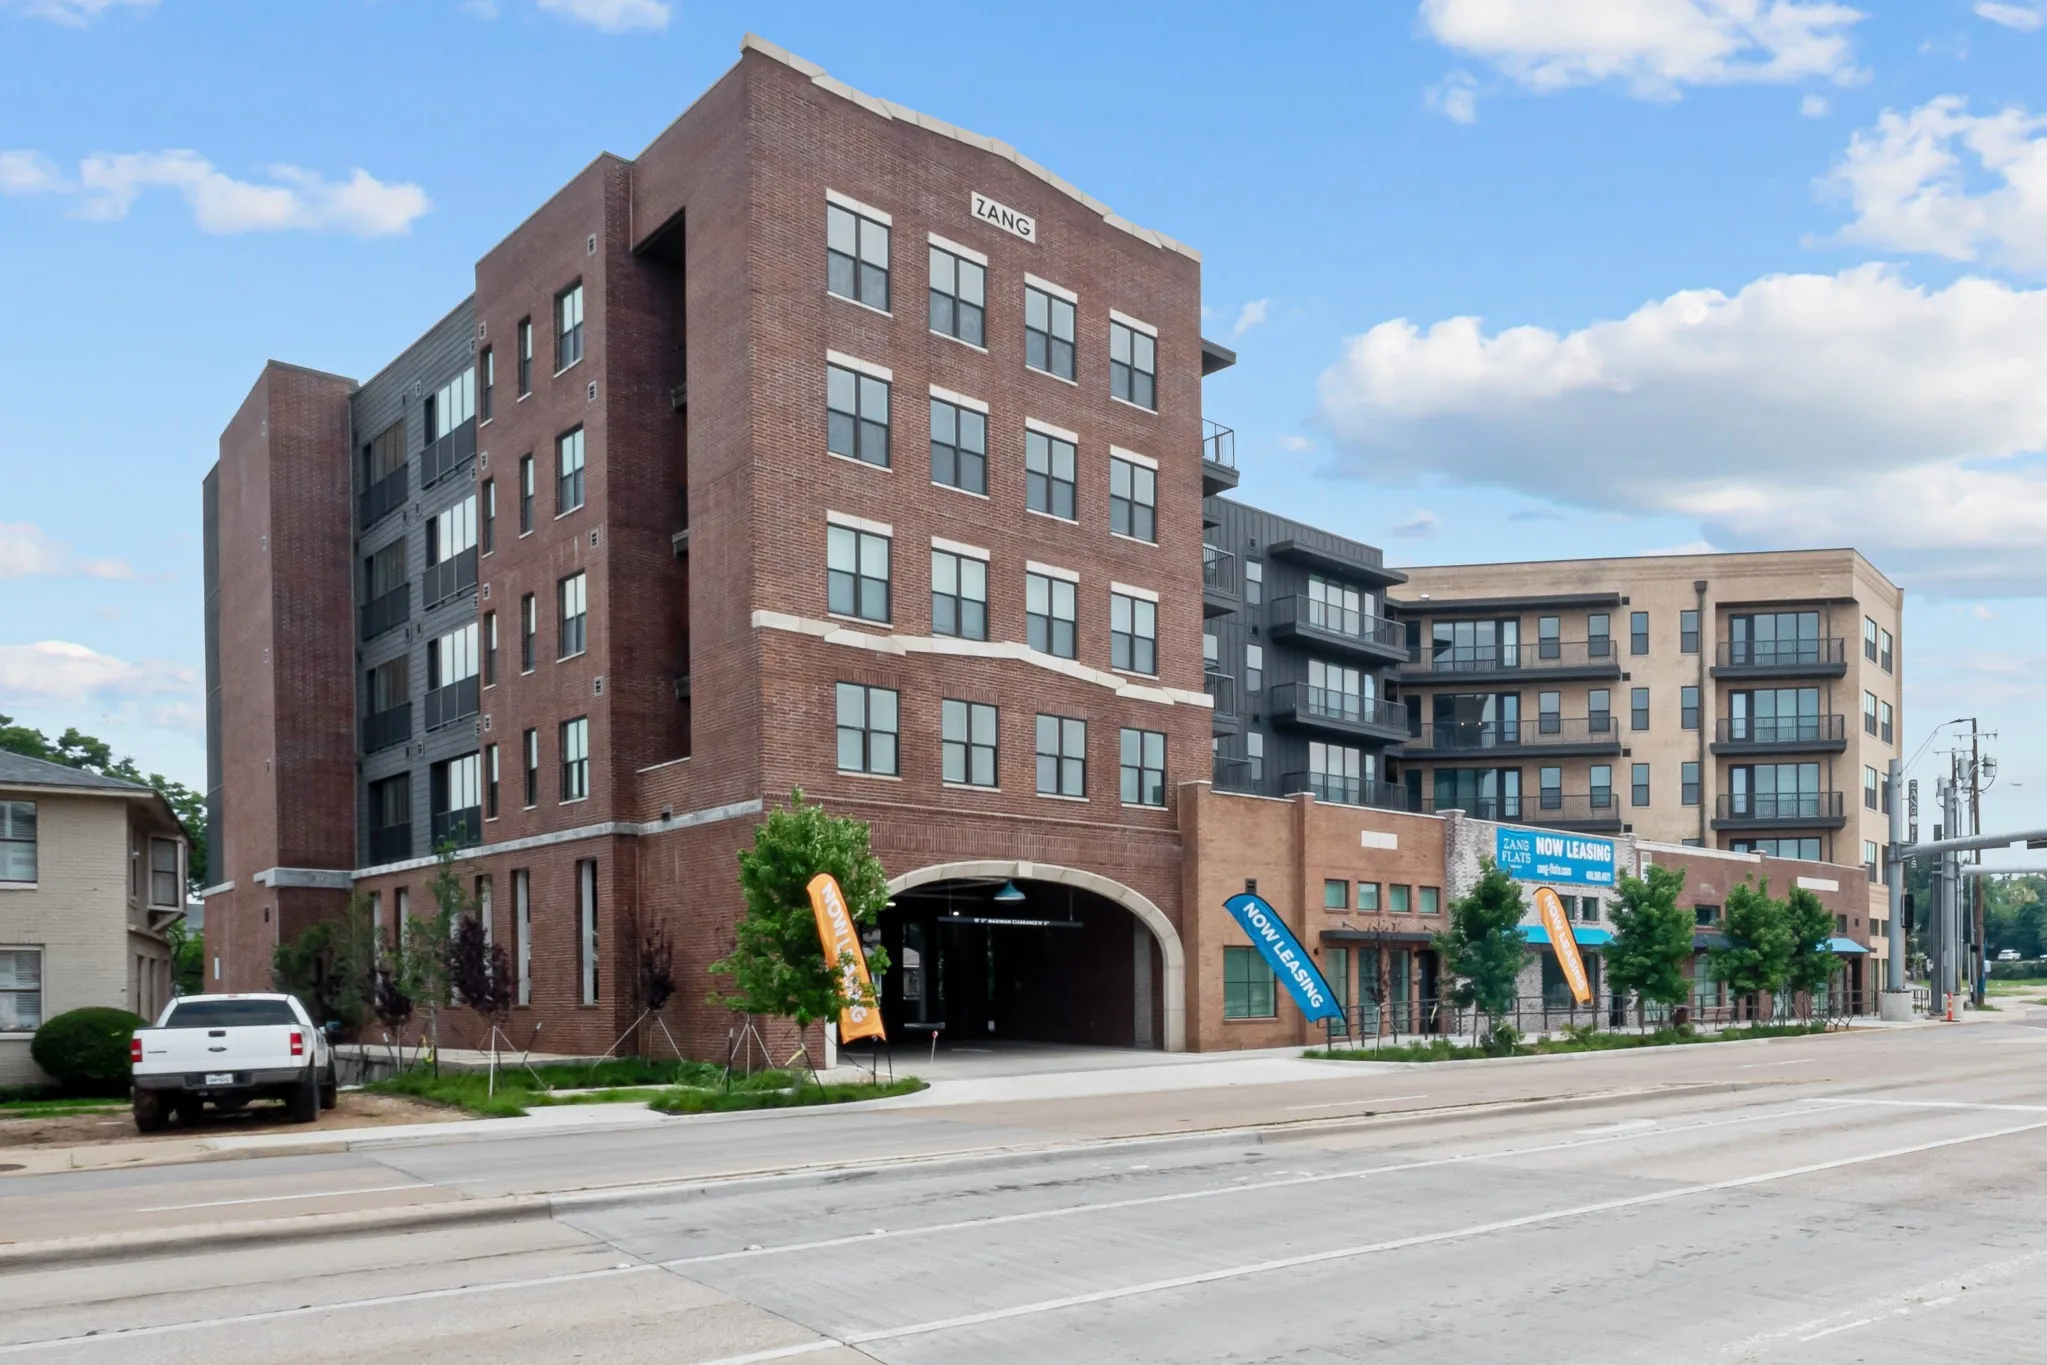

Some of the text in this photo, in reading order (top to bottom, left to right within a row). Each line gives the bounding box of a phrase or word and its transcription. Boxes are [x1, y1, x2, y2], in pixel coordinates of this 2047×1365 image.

[976, 197, 1031, 236] ZANG
[1502, 850, 1531, 864] FLATS
[1503, 838, 1530, 852] ZANG
[1536, 837, 1611, 862] NOW LEASING
[822, 882, 848, 937] NOW
[1243, 902, 1323, 1008] NOW LEASING
[1544, 895, 1586, 991] NOW LEASING
